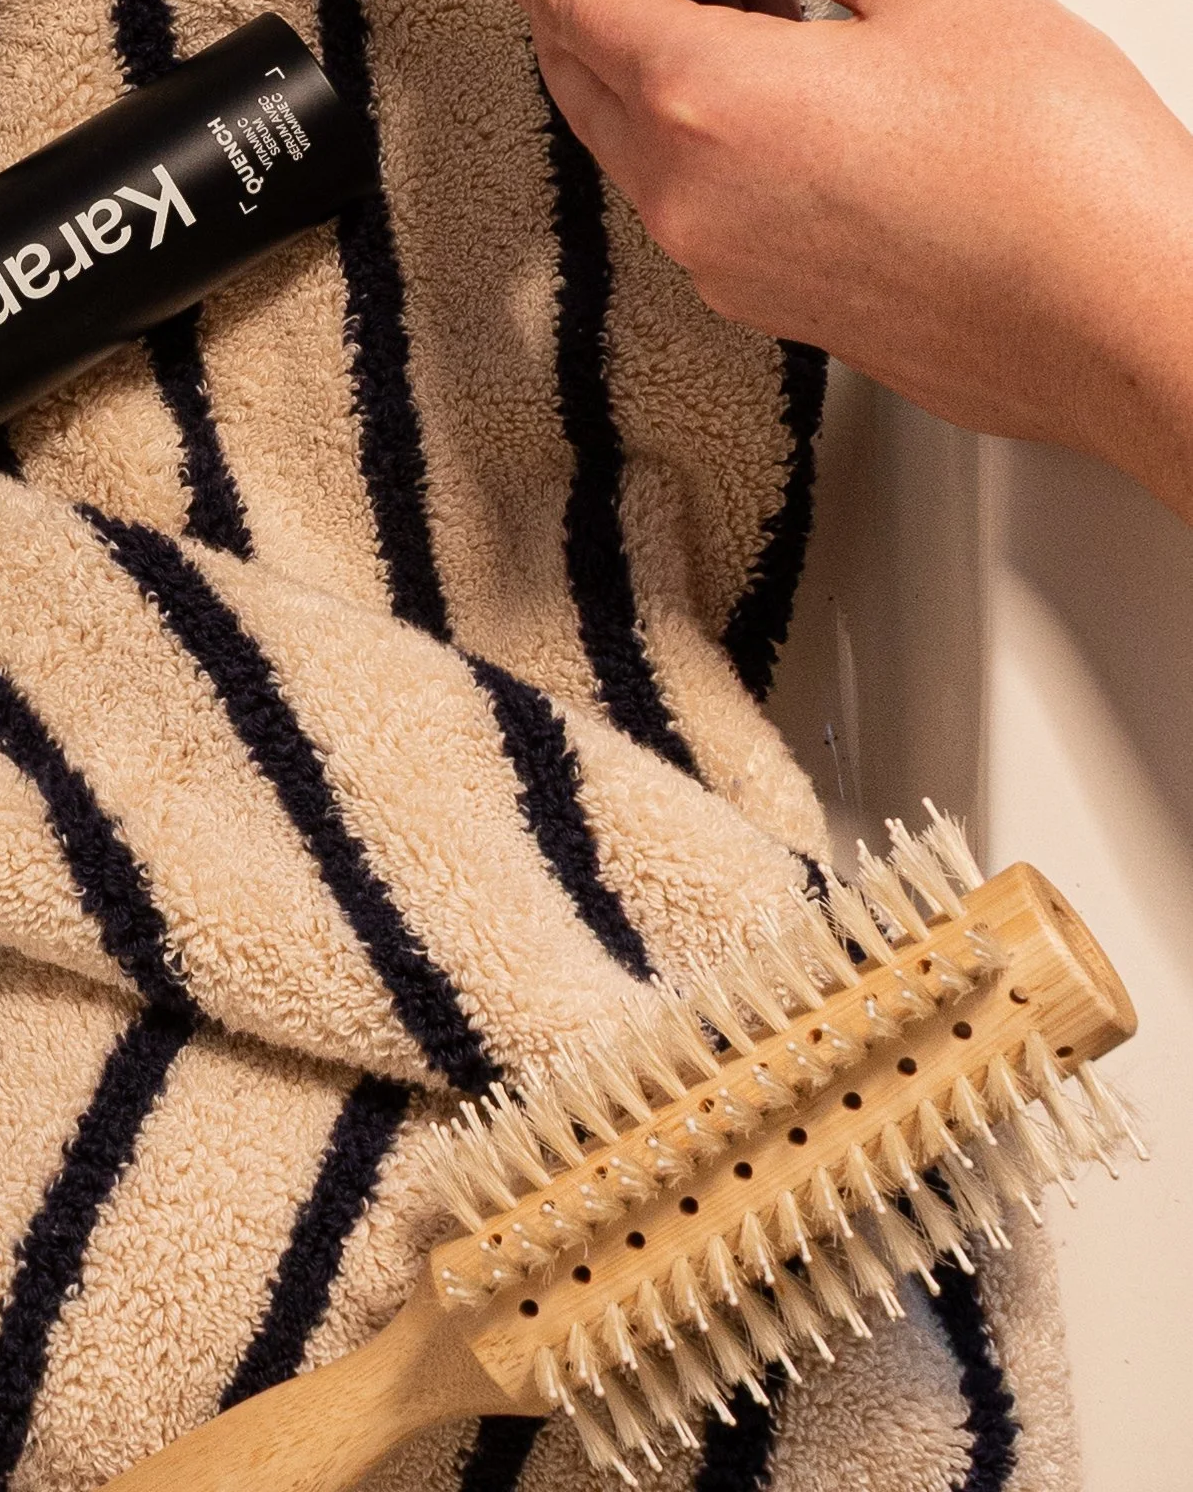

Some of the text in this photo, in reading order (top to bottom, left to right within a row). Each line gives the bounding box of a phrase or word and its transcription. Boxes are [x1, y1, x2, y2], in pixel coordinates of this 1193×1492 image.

[237, 117, 273, 171] VITAMIN C
[252, 116, 281, 156] SERUM
[258, 95, 303, 161] SÉRUM AVEC
[271, 92, 311, 151] VITAMINE C
[207, 116, 264, 195] QUENCH
